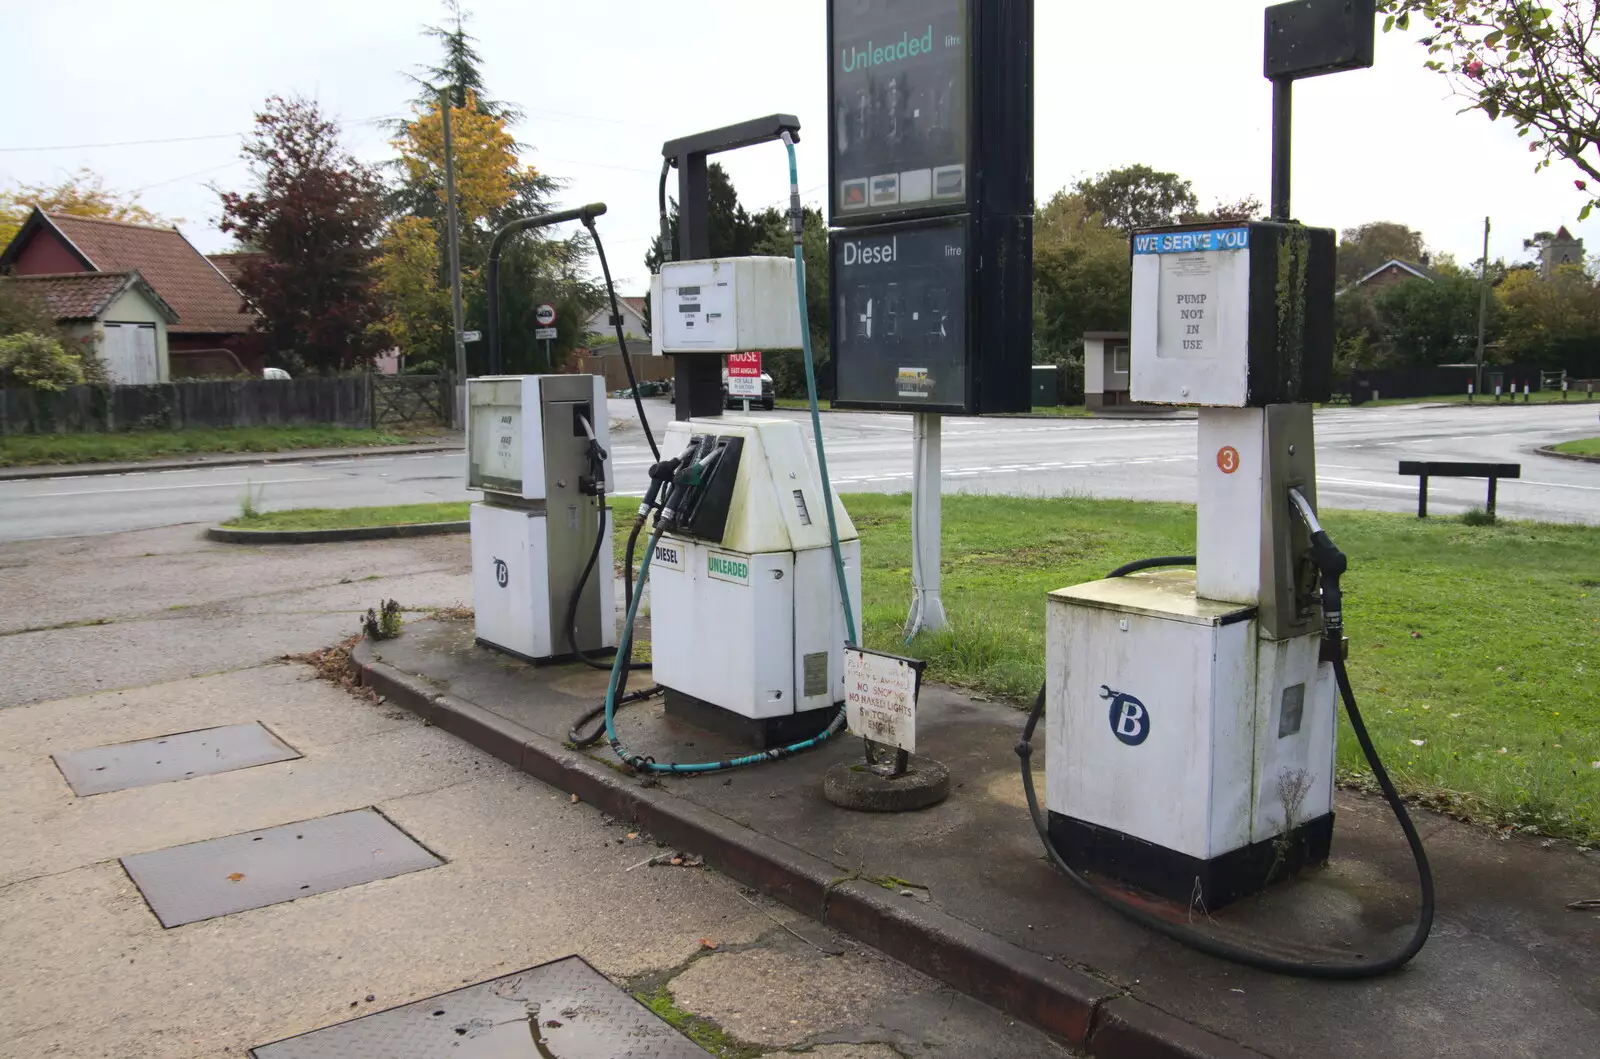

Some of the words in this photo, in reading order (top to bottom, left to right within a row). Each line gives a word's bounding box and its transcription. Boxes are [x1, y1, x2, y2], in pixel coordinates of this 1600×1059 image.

[842, 25, 932, 73] Unleaded
[945, 35, 961, 49] litre
[844, 236, 897, 266] Diesel
[945, 244, 962, 257] litre
[1136, 237, 1159, 252] WE
[1163, 233, 1211, 251] SERVE
[1217, 231, 1247, 248] YOU
[1176, 294, 1207, 304] PUMP
[1181, 309, 1204, 320] NOT
[1186, 324, 1200, 335] IN
[1182, 340, 1203, 350] USE
[1223, 450, 1234, 470] 3
[655, 546, 678, 564] DIESEL
[708, 557, 748, 579] UNLEADED
[857, 682, 869, 693] NO
[849, 692, 860, 702] NO
[861, 695, 886, 708] NAKED
[887, 701, 912, 717] LIGHTS
[868, 719, 896, 735] ENGINE
[1116, 701, 1143, 737] B
